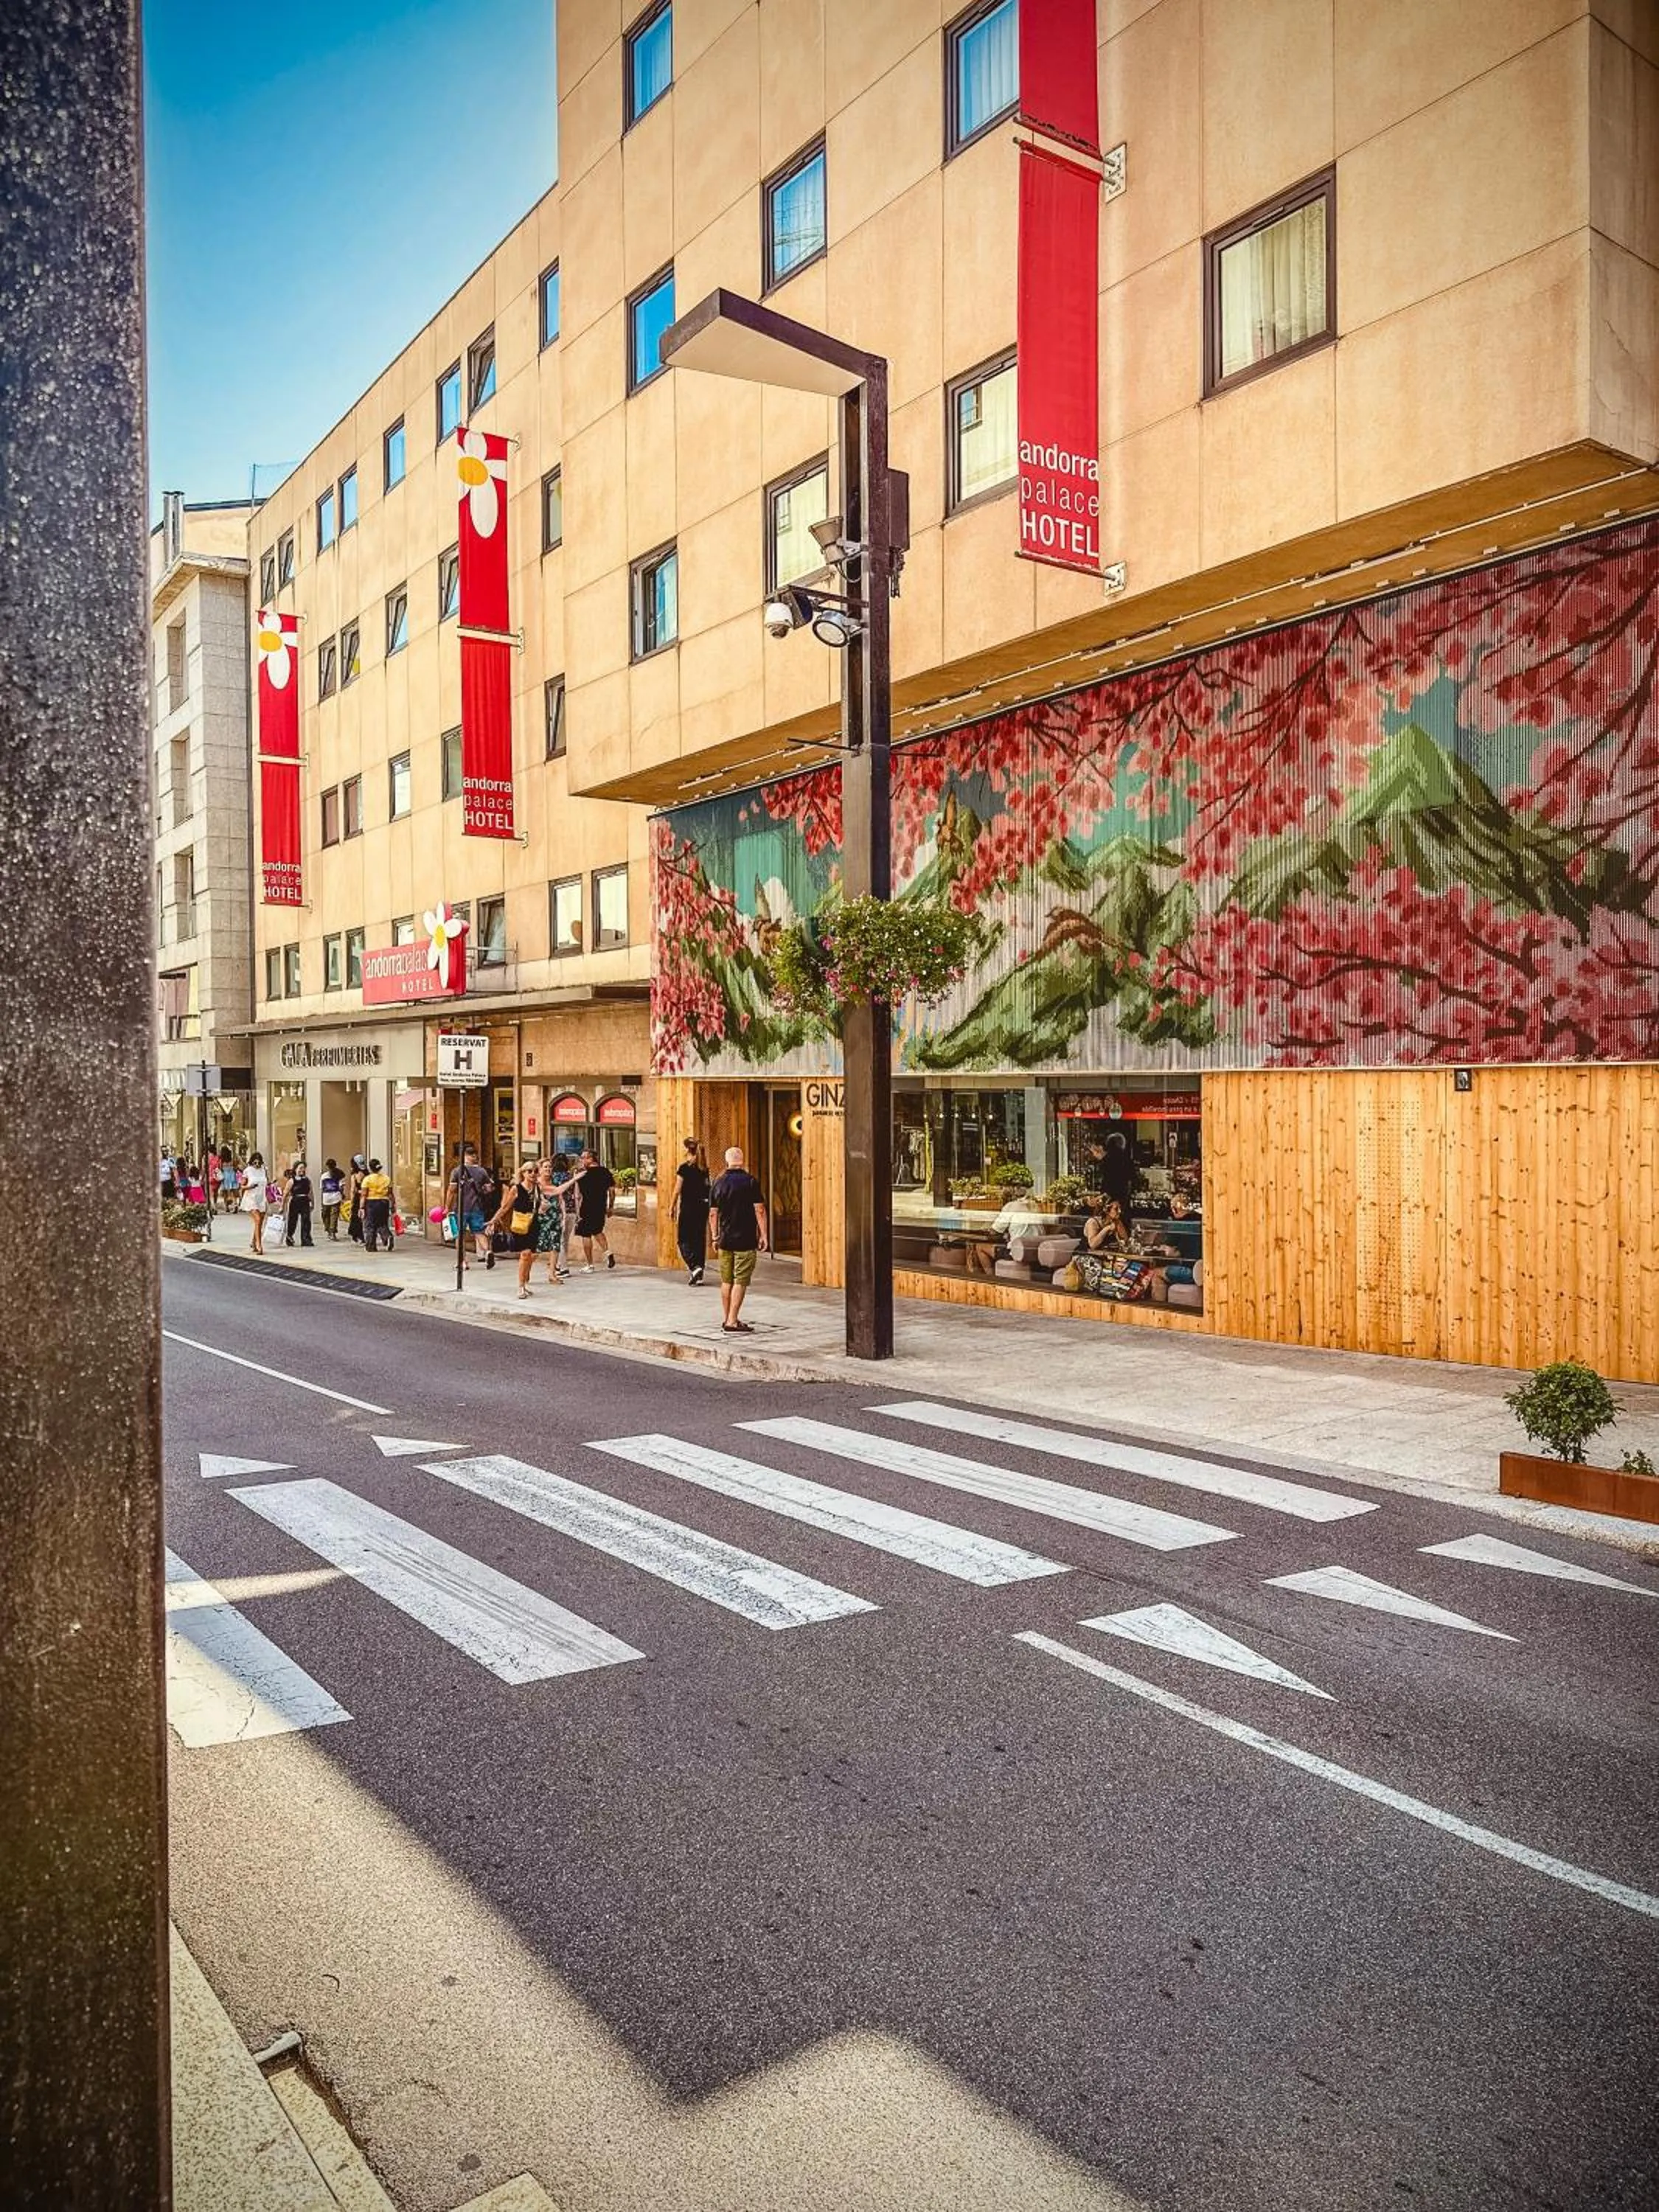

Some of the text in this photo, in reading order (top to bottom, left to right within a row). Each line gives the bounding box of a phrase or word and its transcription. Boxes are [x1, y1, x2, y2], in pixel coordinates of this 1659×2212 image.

[1019, 440, 1099, 481] andorra
[1020, 476, 1099, 517] palace
[1022, 508, 1099, 557] HOTEL
[462, 776, 512, 793] andorra
[464, 793, 512, 810] palace
[465, 810, 513, 830] HOTEL
[262, 860, 301, 874] andorra
[263, 886, 301, 900] HOTEL
[365, 947, 428, 980] andorrapalac
[401, 977, 434, 992] HOTEL
[440, 1037, 487, 1047] RESERVAT
[454, 1049, 473, 1070] H
[807, 1083, 844, 1107] GINZ
